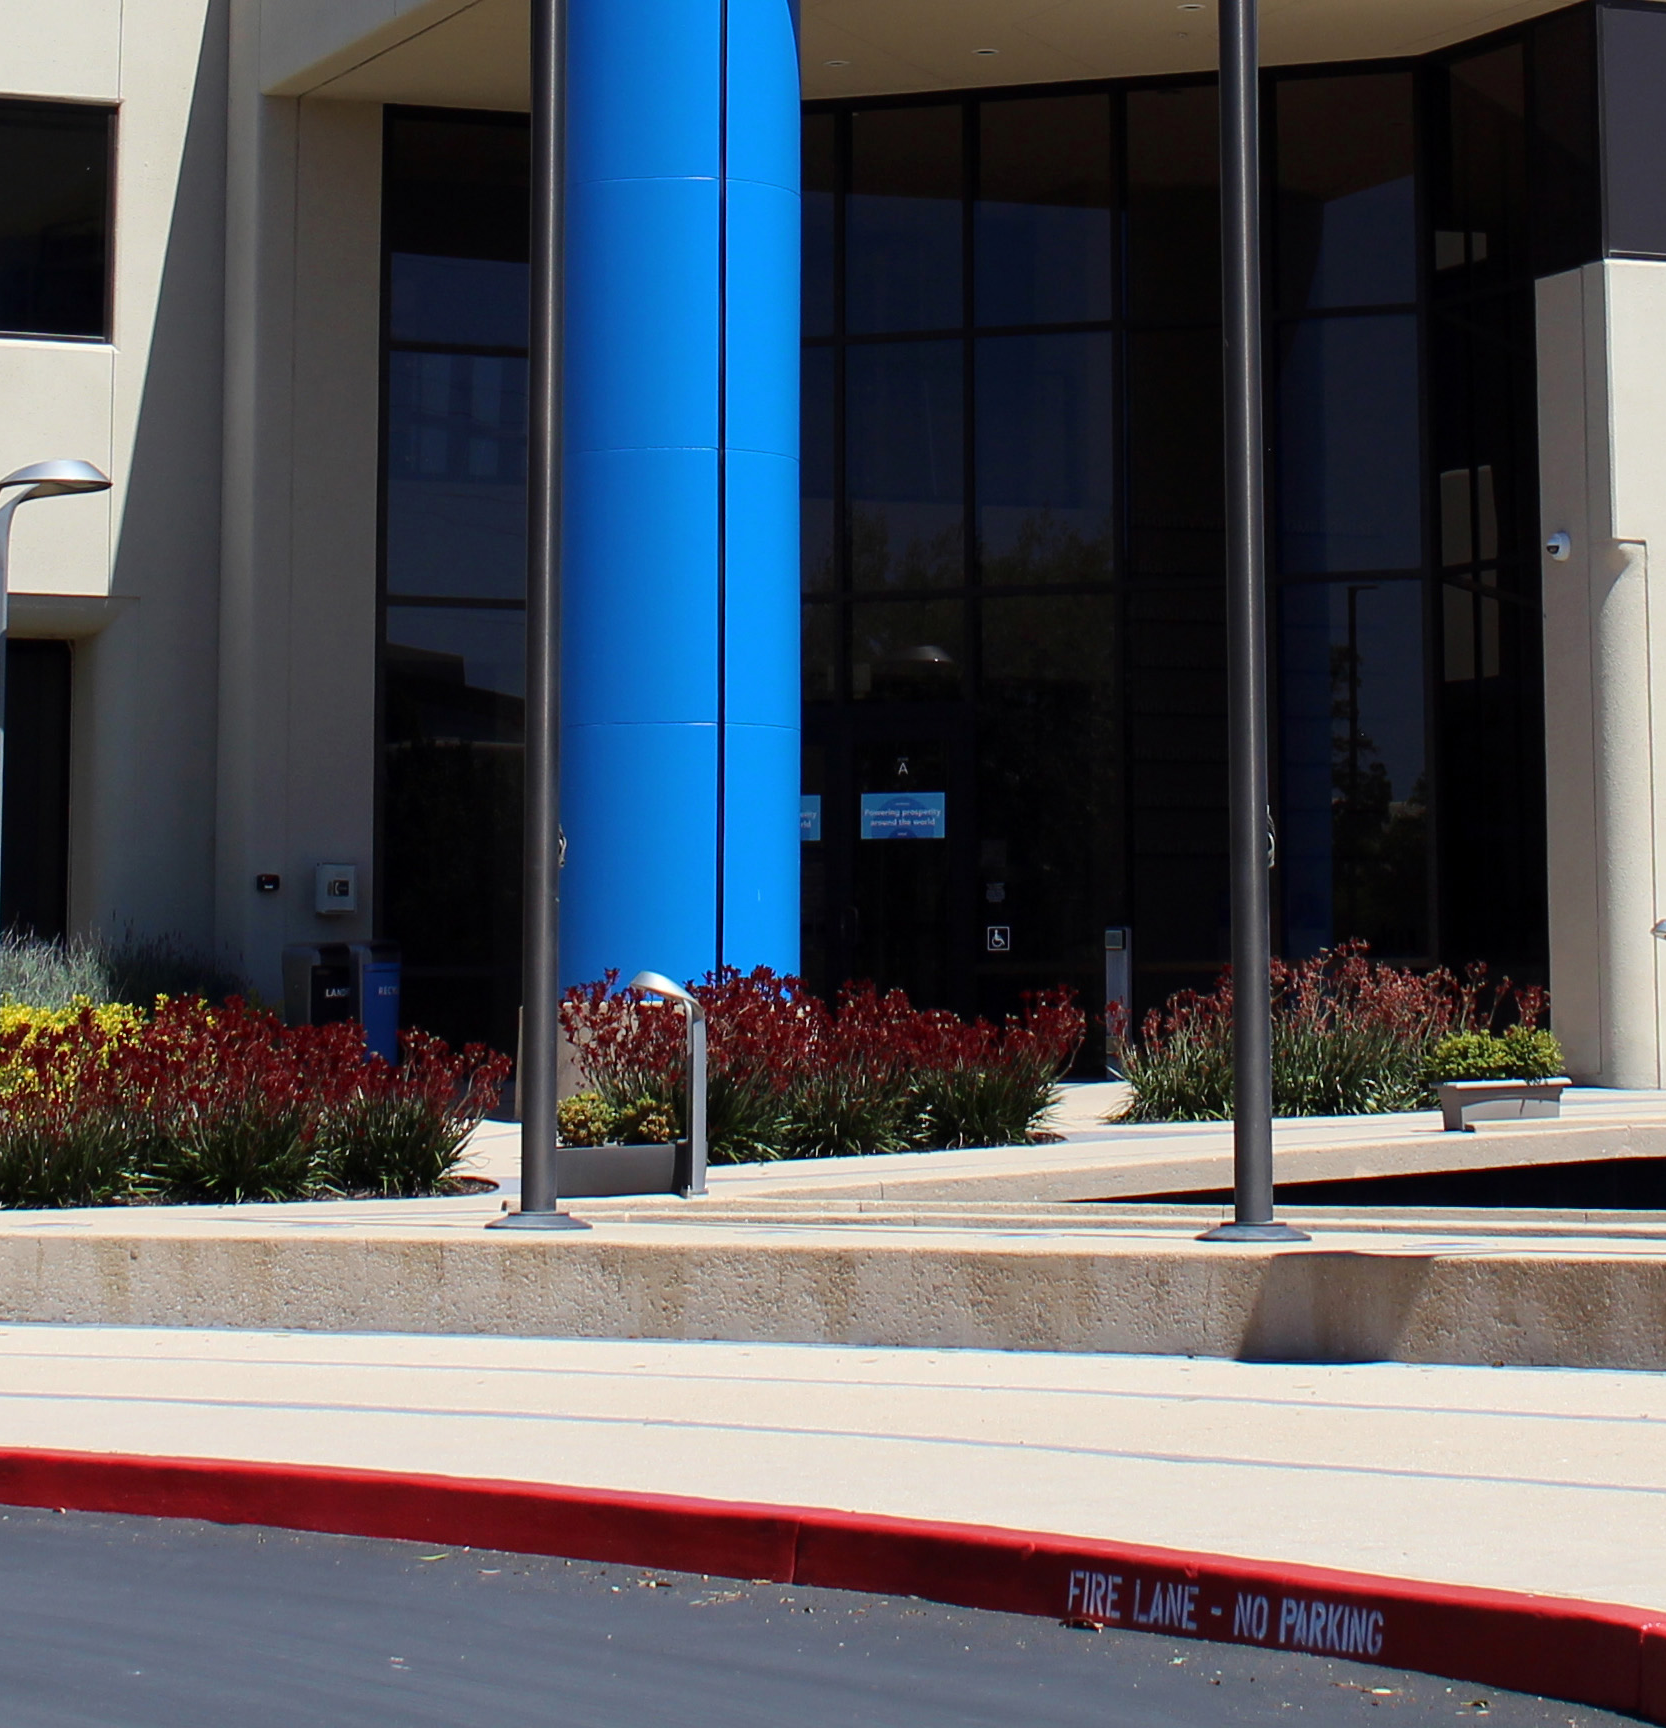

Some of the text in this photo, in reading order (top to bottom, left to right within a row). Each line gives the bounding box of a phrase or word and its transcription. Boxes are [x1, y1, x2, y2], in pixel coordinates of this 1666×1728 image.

[898, 762, 909, 775] A
[864, 808, 941, 818] Powering prosperity
[870, 818, 936, 826] around the world
[1068, 1569, 1122, 1619] FIRE
[1134, 1578, 1199, 1631] LANE
[1235, 1591, 1268, 1640] NO
[1279, 1597, 1384, 1656] PARKING
